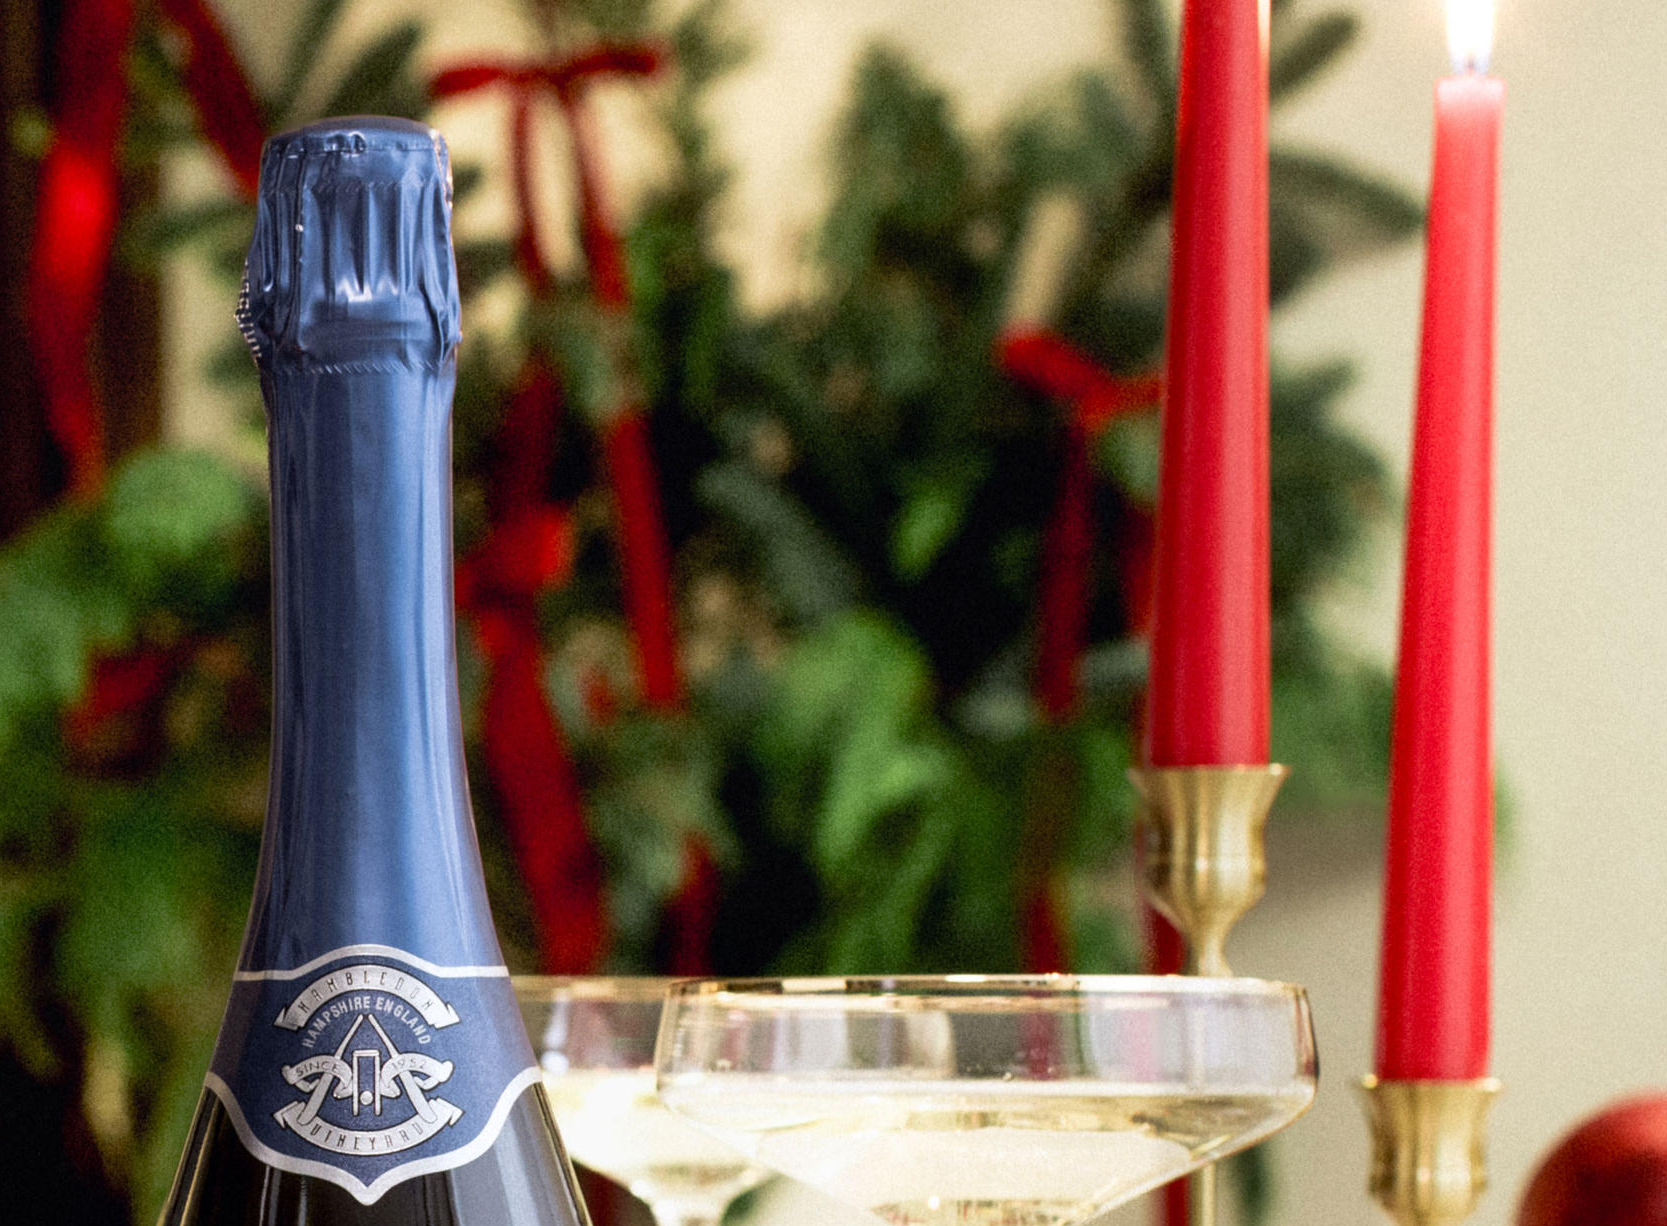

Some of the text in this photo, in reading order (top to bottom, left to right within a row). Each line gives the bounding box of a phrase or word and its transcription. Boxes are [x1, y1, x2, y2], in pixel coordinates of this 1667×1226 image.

[298, 970, 435, 1013] HAMBLEDON
[302, 996, 432, 1048] HAMPSHIRE ENGLAND
[296, 1060, 340, 1077] SINCE
[311, 1123, 425, 1151] VINEYARD
